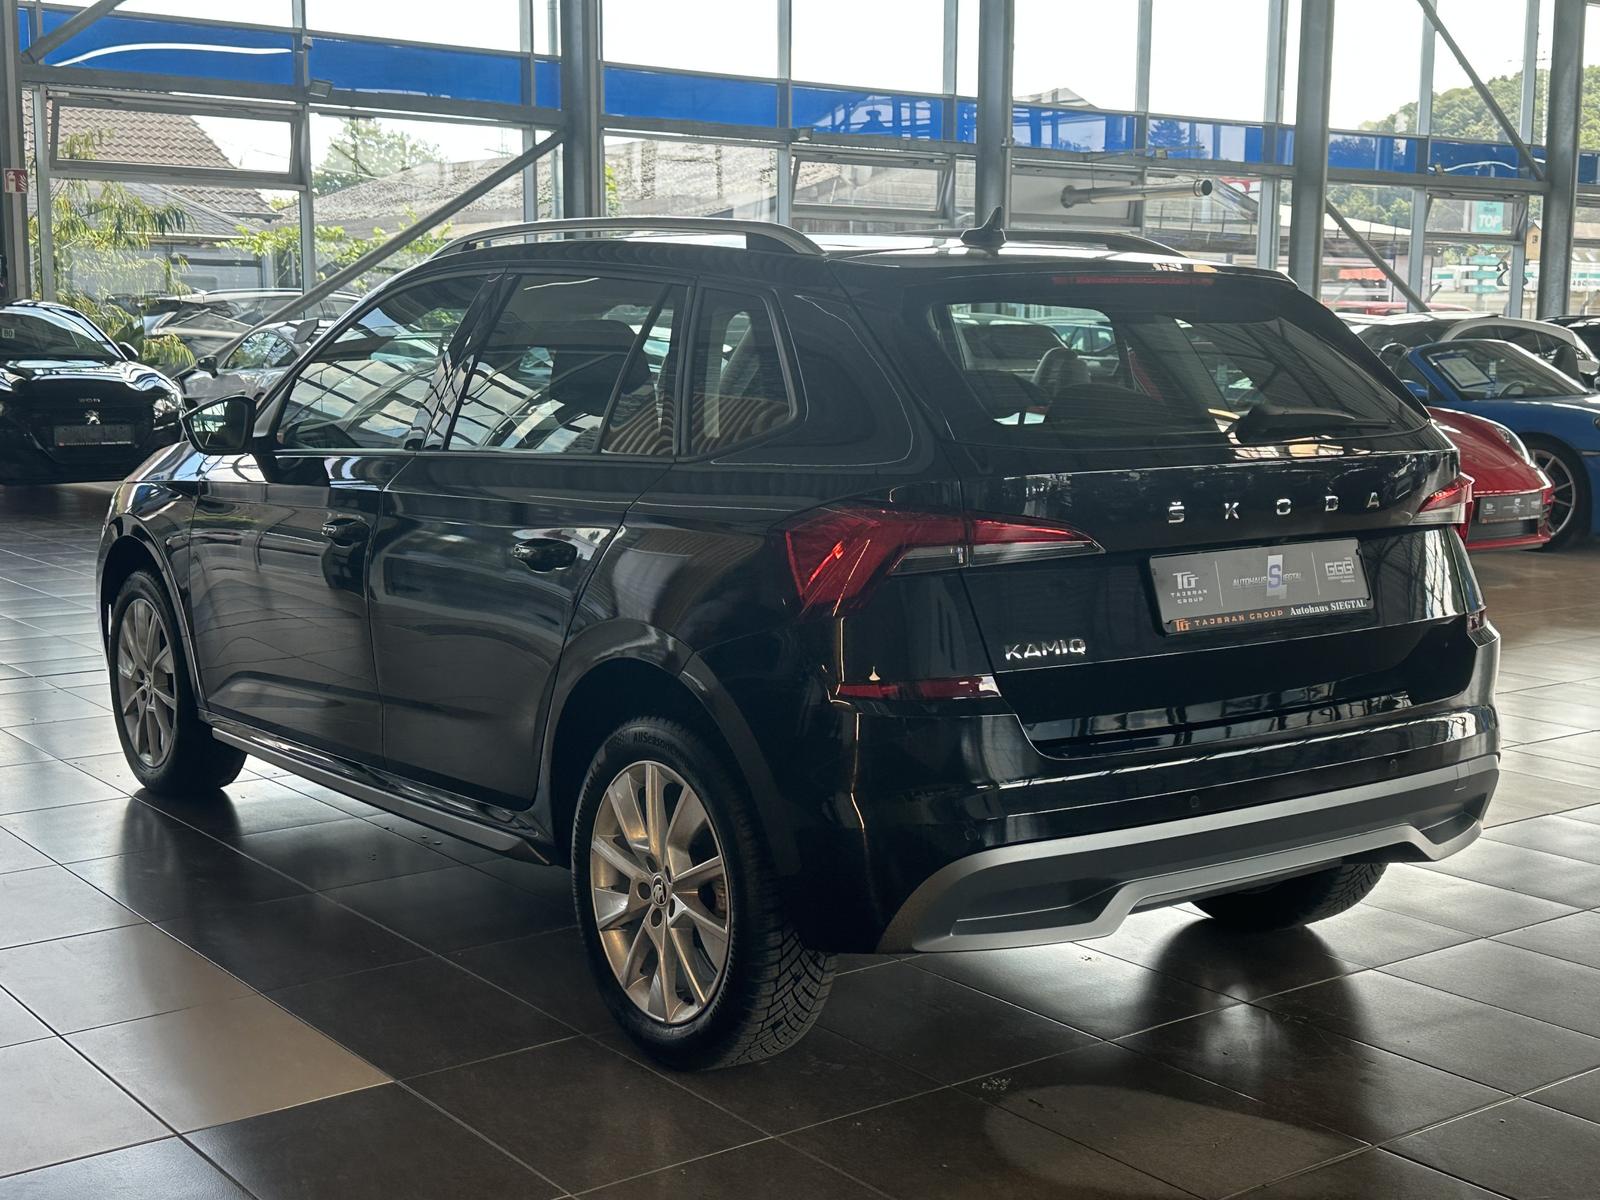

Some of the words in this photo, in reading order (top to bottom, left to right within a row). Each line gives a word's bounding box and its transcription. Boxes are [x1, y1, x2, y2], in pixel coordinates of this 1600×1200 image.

[1479, 214, 1503, 228] TOP
[1168, 491, 1381, 524] ŠKODA
[1249, 609, 1284, 620] GROUP
[1290, 605, 1329, 616] Autohaus
[1330, 599, 1367, 611] SIEGTAL
[1005, 638, 1086, 661] KAMIQ
